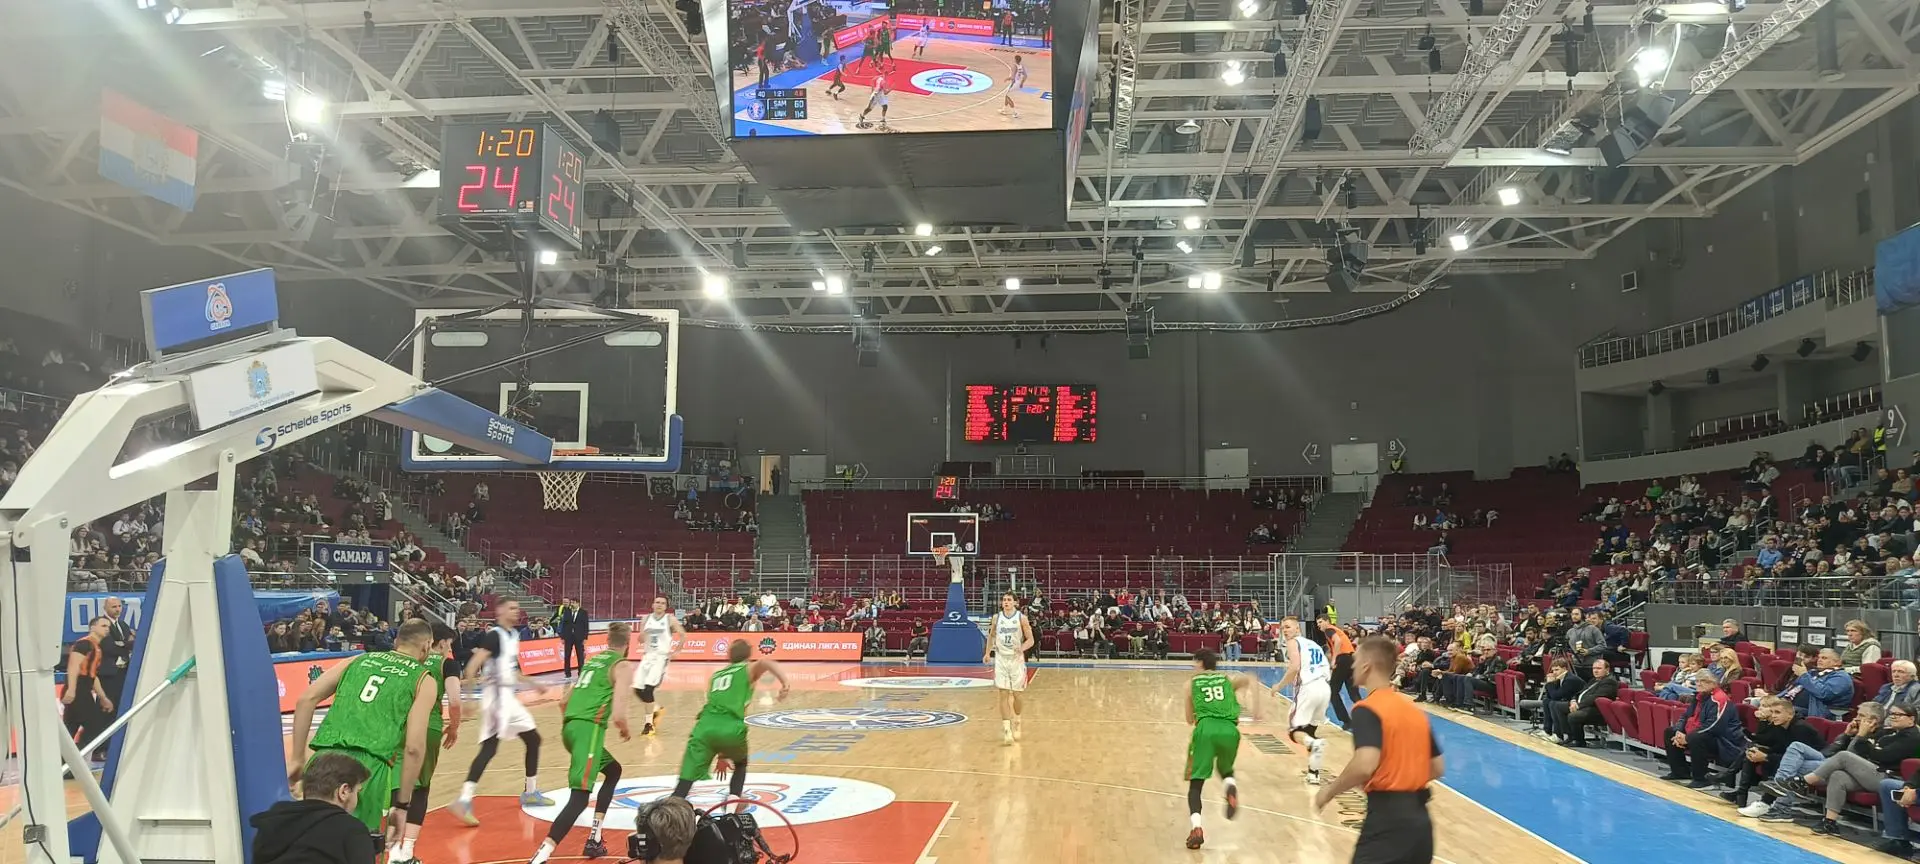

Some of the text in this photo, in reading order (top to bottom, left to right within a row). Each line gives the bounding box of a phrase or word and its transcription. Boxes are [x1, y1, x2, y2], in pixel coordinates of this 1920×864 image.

[794, 100, 804, 108] 60
[478, 129, 535, 157] 1:20
[557, 145, 582, 184] 1:20
[458, 165, 519, 208] 24
[548, 174, 575, 225] 24
[277, 403, 352, 437] Schelde Sports
[488, 417, 515, 435] Schelde
[1887, 409, 1894, 427] 9
[487, 427, 514, 444] Sports
[1311, 444, 1318, 454] 7
[1389, 440, 1396, 451] 8
[940, 477, 955, 486] 1:20
[935, 486, 952, 498] 24
[333, 549, 372, 564] САМАРА
[687, 639, 706, 648] 17:00
[782, 642, 858, 650] ЕДИНАЯ ЛИГА ВТБ
[1308, 647, 1323, 665] 30
[360, 674, 386, 702] 6
[1201, 685, 1225, 703] 38
[779, 733, 866, 752] ВТБ
[782, 787, 838, 814] САМАРА
